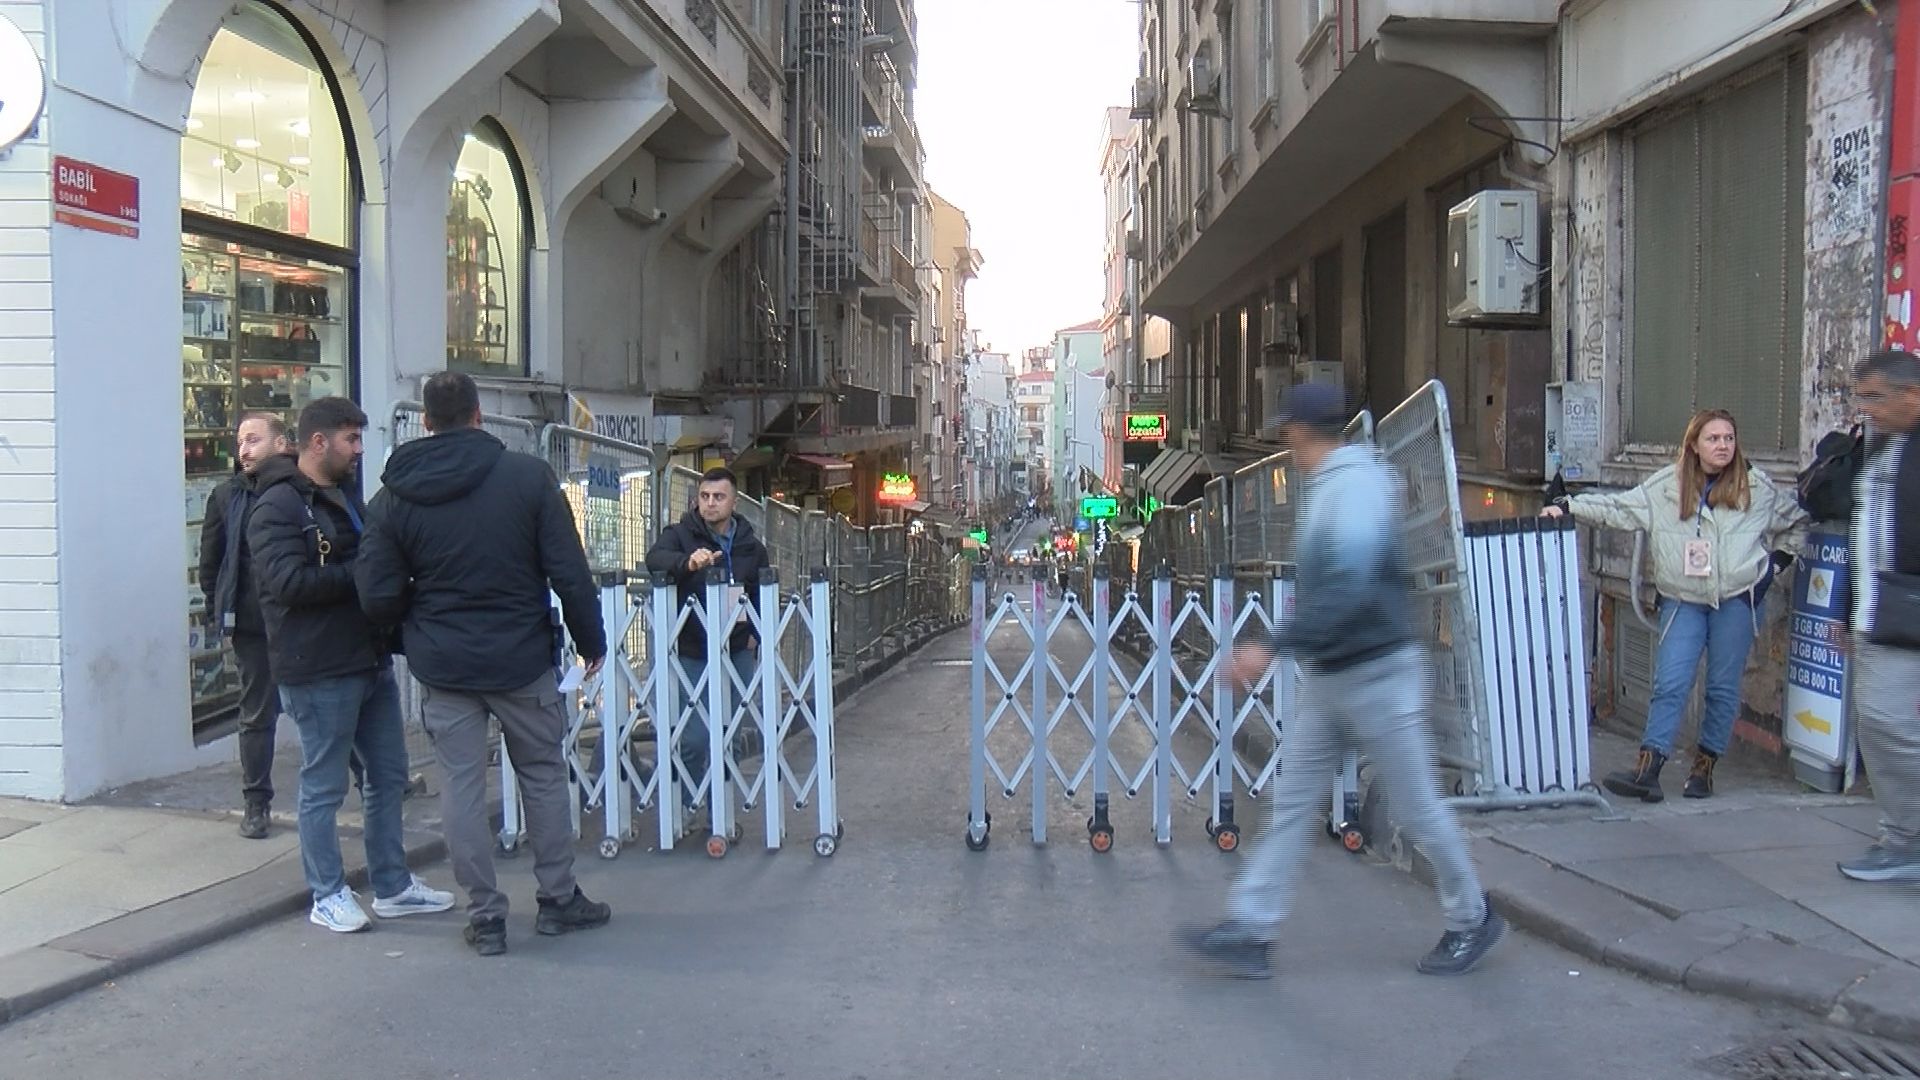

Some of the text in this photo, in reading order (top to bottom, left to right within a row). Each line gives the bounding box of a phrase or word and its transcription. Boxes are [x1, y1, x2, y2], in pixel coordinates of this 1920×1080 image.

[1834, 126, 1870, 159] BOYA
[59, 165, 97, 193] BABİL
[1565, 403, 1597, 416] BOYA
[594, 414, 648, 446] TURKCELL
[1800, 619, 1813, 636] GB
[1813, 622, 1829, 640] 500
[1799, 642, 1811, 659] GB
[1812, 646, 1828, 663] 600
[1829, 650, 1841, 667] TL
[1798, 668, 1810, 684] GB
[1811, 672, 1826, 690] 800
[1828, 676, 1841, 694] TL
